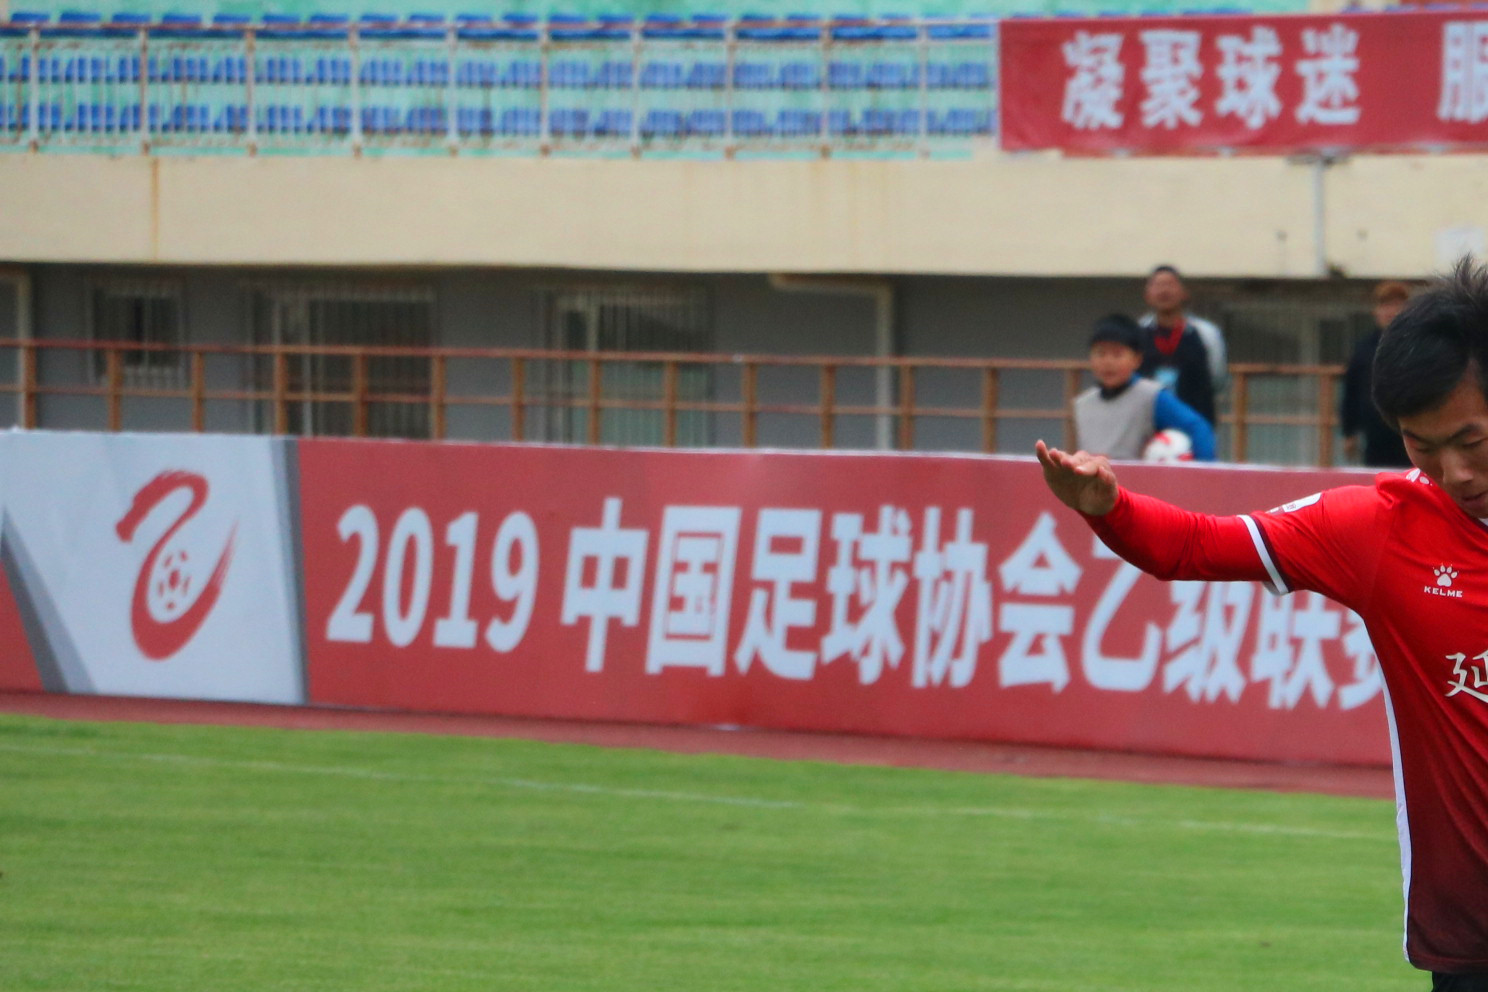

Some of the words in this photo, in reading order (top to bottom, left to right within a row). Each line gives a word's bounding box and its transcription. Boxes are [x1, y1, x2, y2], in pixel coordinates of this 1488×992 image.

[1061, 24, 1361, 130] 凝聚球迷
[325, 503, 540, 653] 2019
[1424, 585, 1464, 598] KELME
